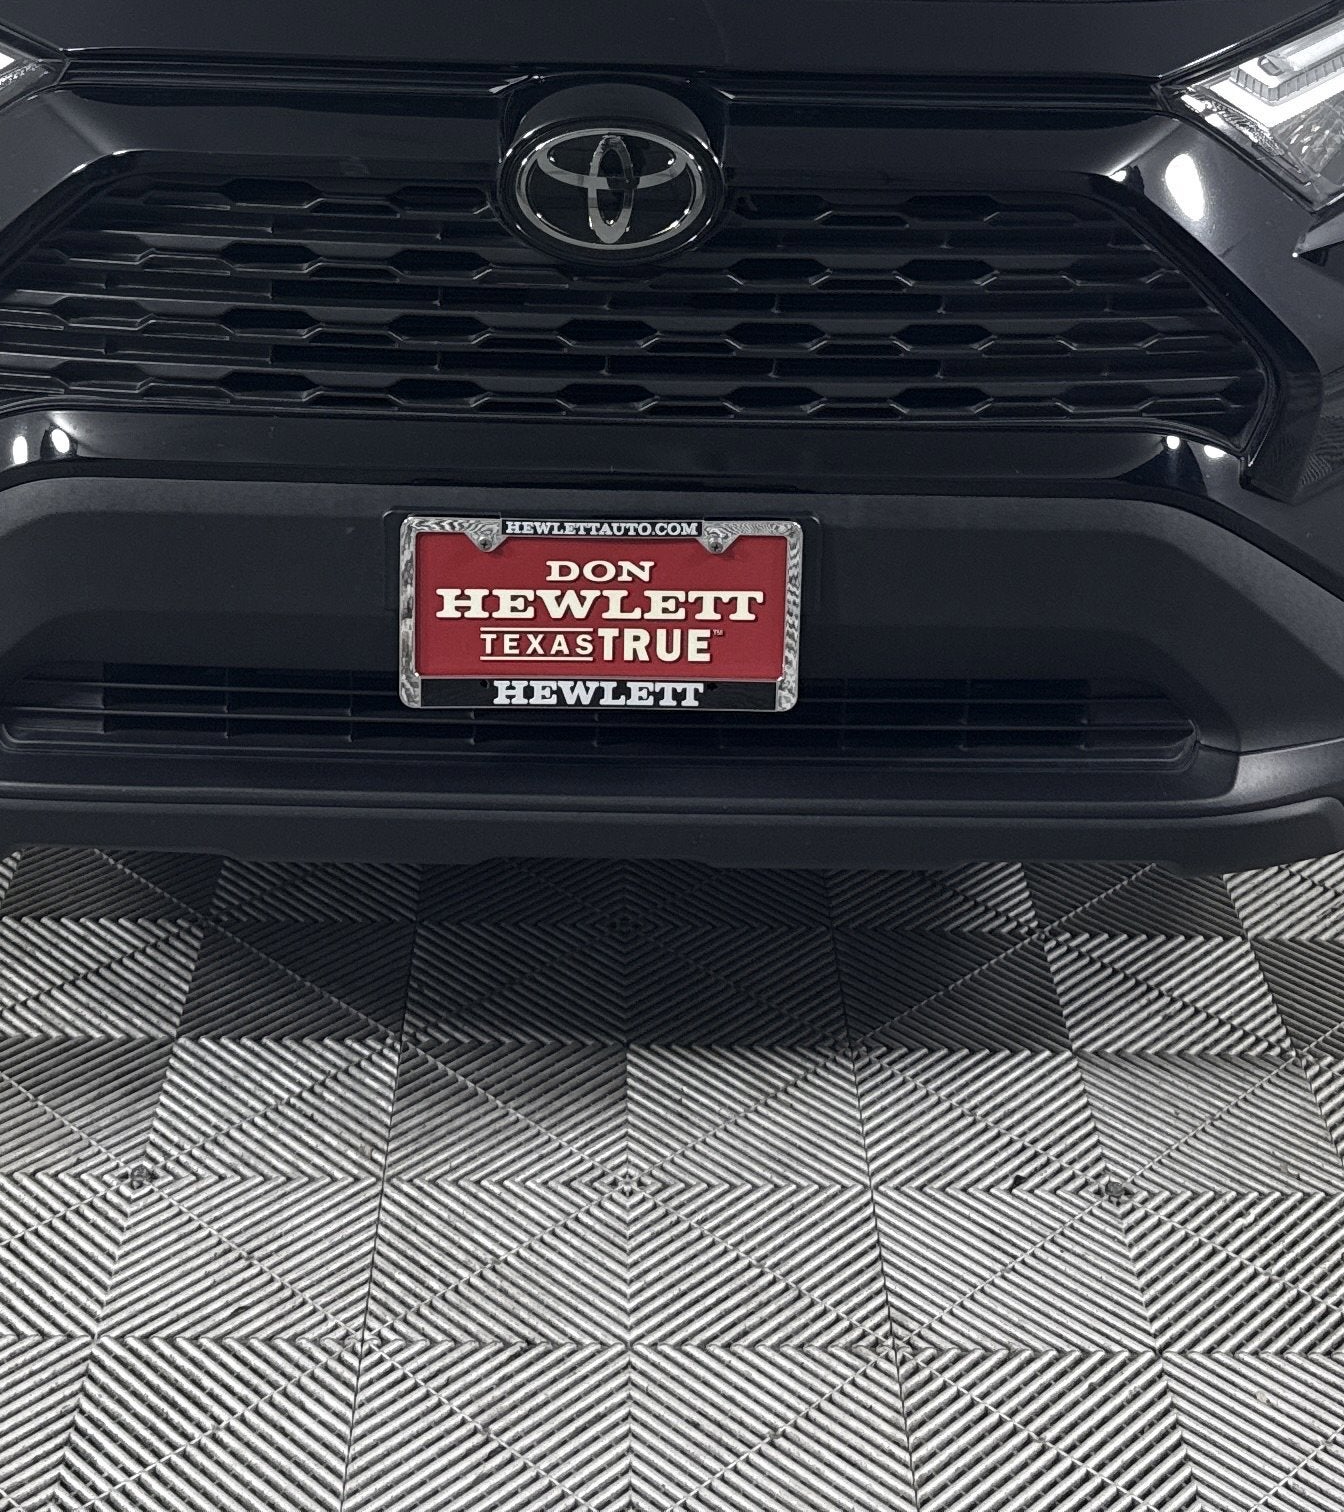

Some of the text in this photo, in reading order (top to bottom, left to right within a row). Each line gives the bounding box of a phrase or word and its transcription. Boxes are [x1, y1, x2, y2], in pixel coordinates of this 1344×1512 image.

[505, 520, 699, 537] HEWLETTAUTO.COM
[545, 560, 656, 583] DON
[435, 588, 765, 621] HEWLETT
[492, 679, 705, 707] HEWLETT
